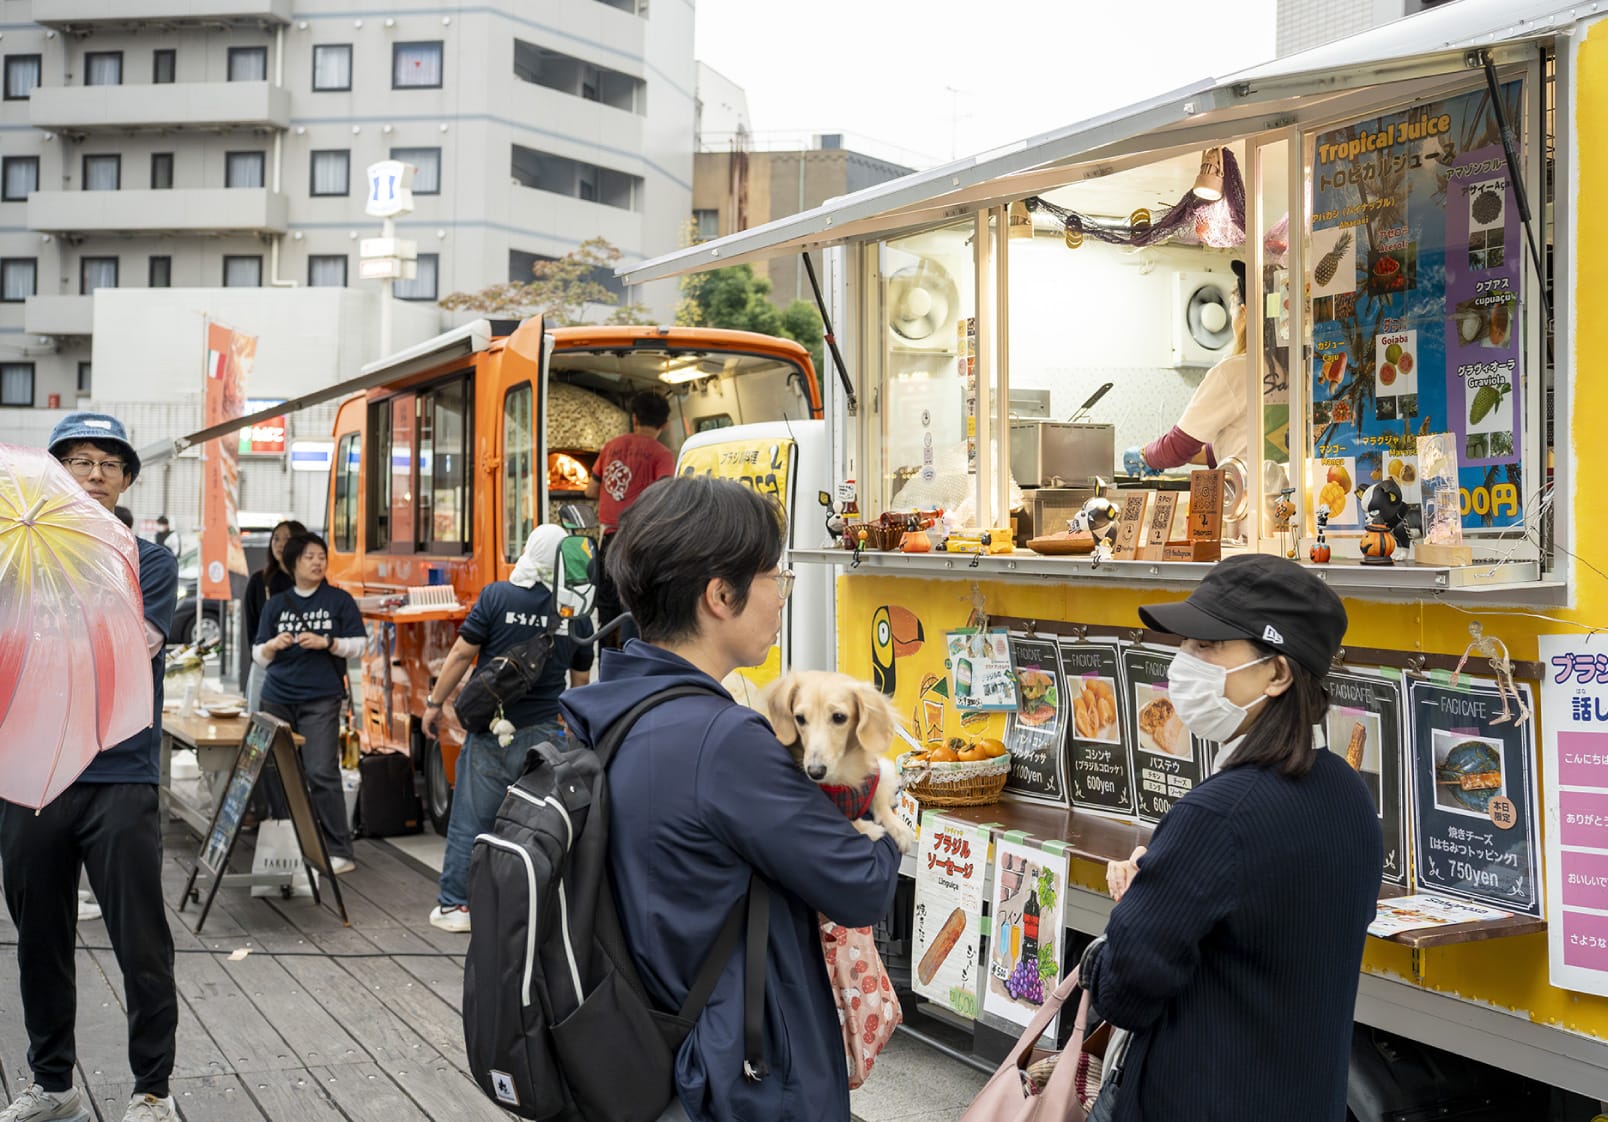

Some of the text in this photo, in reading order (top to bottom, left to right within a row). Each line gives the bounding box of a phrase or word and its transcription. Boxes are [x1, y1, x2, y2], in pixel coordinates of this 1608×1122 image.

[1318, 112, 1451, 165] Tropical Juice
[1319, 142, 1457, 192] トロピカルジュース
[1446, 155, 1520, 181] アマゾンフルー
[1474, 293, 1511, 307] cupuaçu
[1316, 340, 1345, 351] カジュー
[1381, 335, 1409, 346] Goiaba
[1457, 358, 1517, 377] グラヴィオーラ
[1467, 374, 1506, 389] Graviola
[1319, 444, 1346, 455] マンゴー
[1457, 482, 1519, 517] 00円
[1571, 696, 1608, 722] 話し
[1012, 762, 1043, 784] 1100yen
[1149, 758, 1181, 773] パステウ
[1086, 775, 1116, 795] 600yen
[1493, 801, 1510, 813] 本日
[1493, 811, 1512, 824] 限定
[932, 831, 972, 859] ブラジル
[1448, 826, 1494, 846] 焼きチーズ
[926, 852, 974, 880] ソーセージ
[1448, 860, 1499, 888] 750yen
